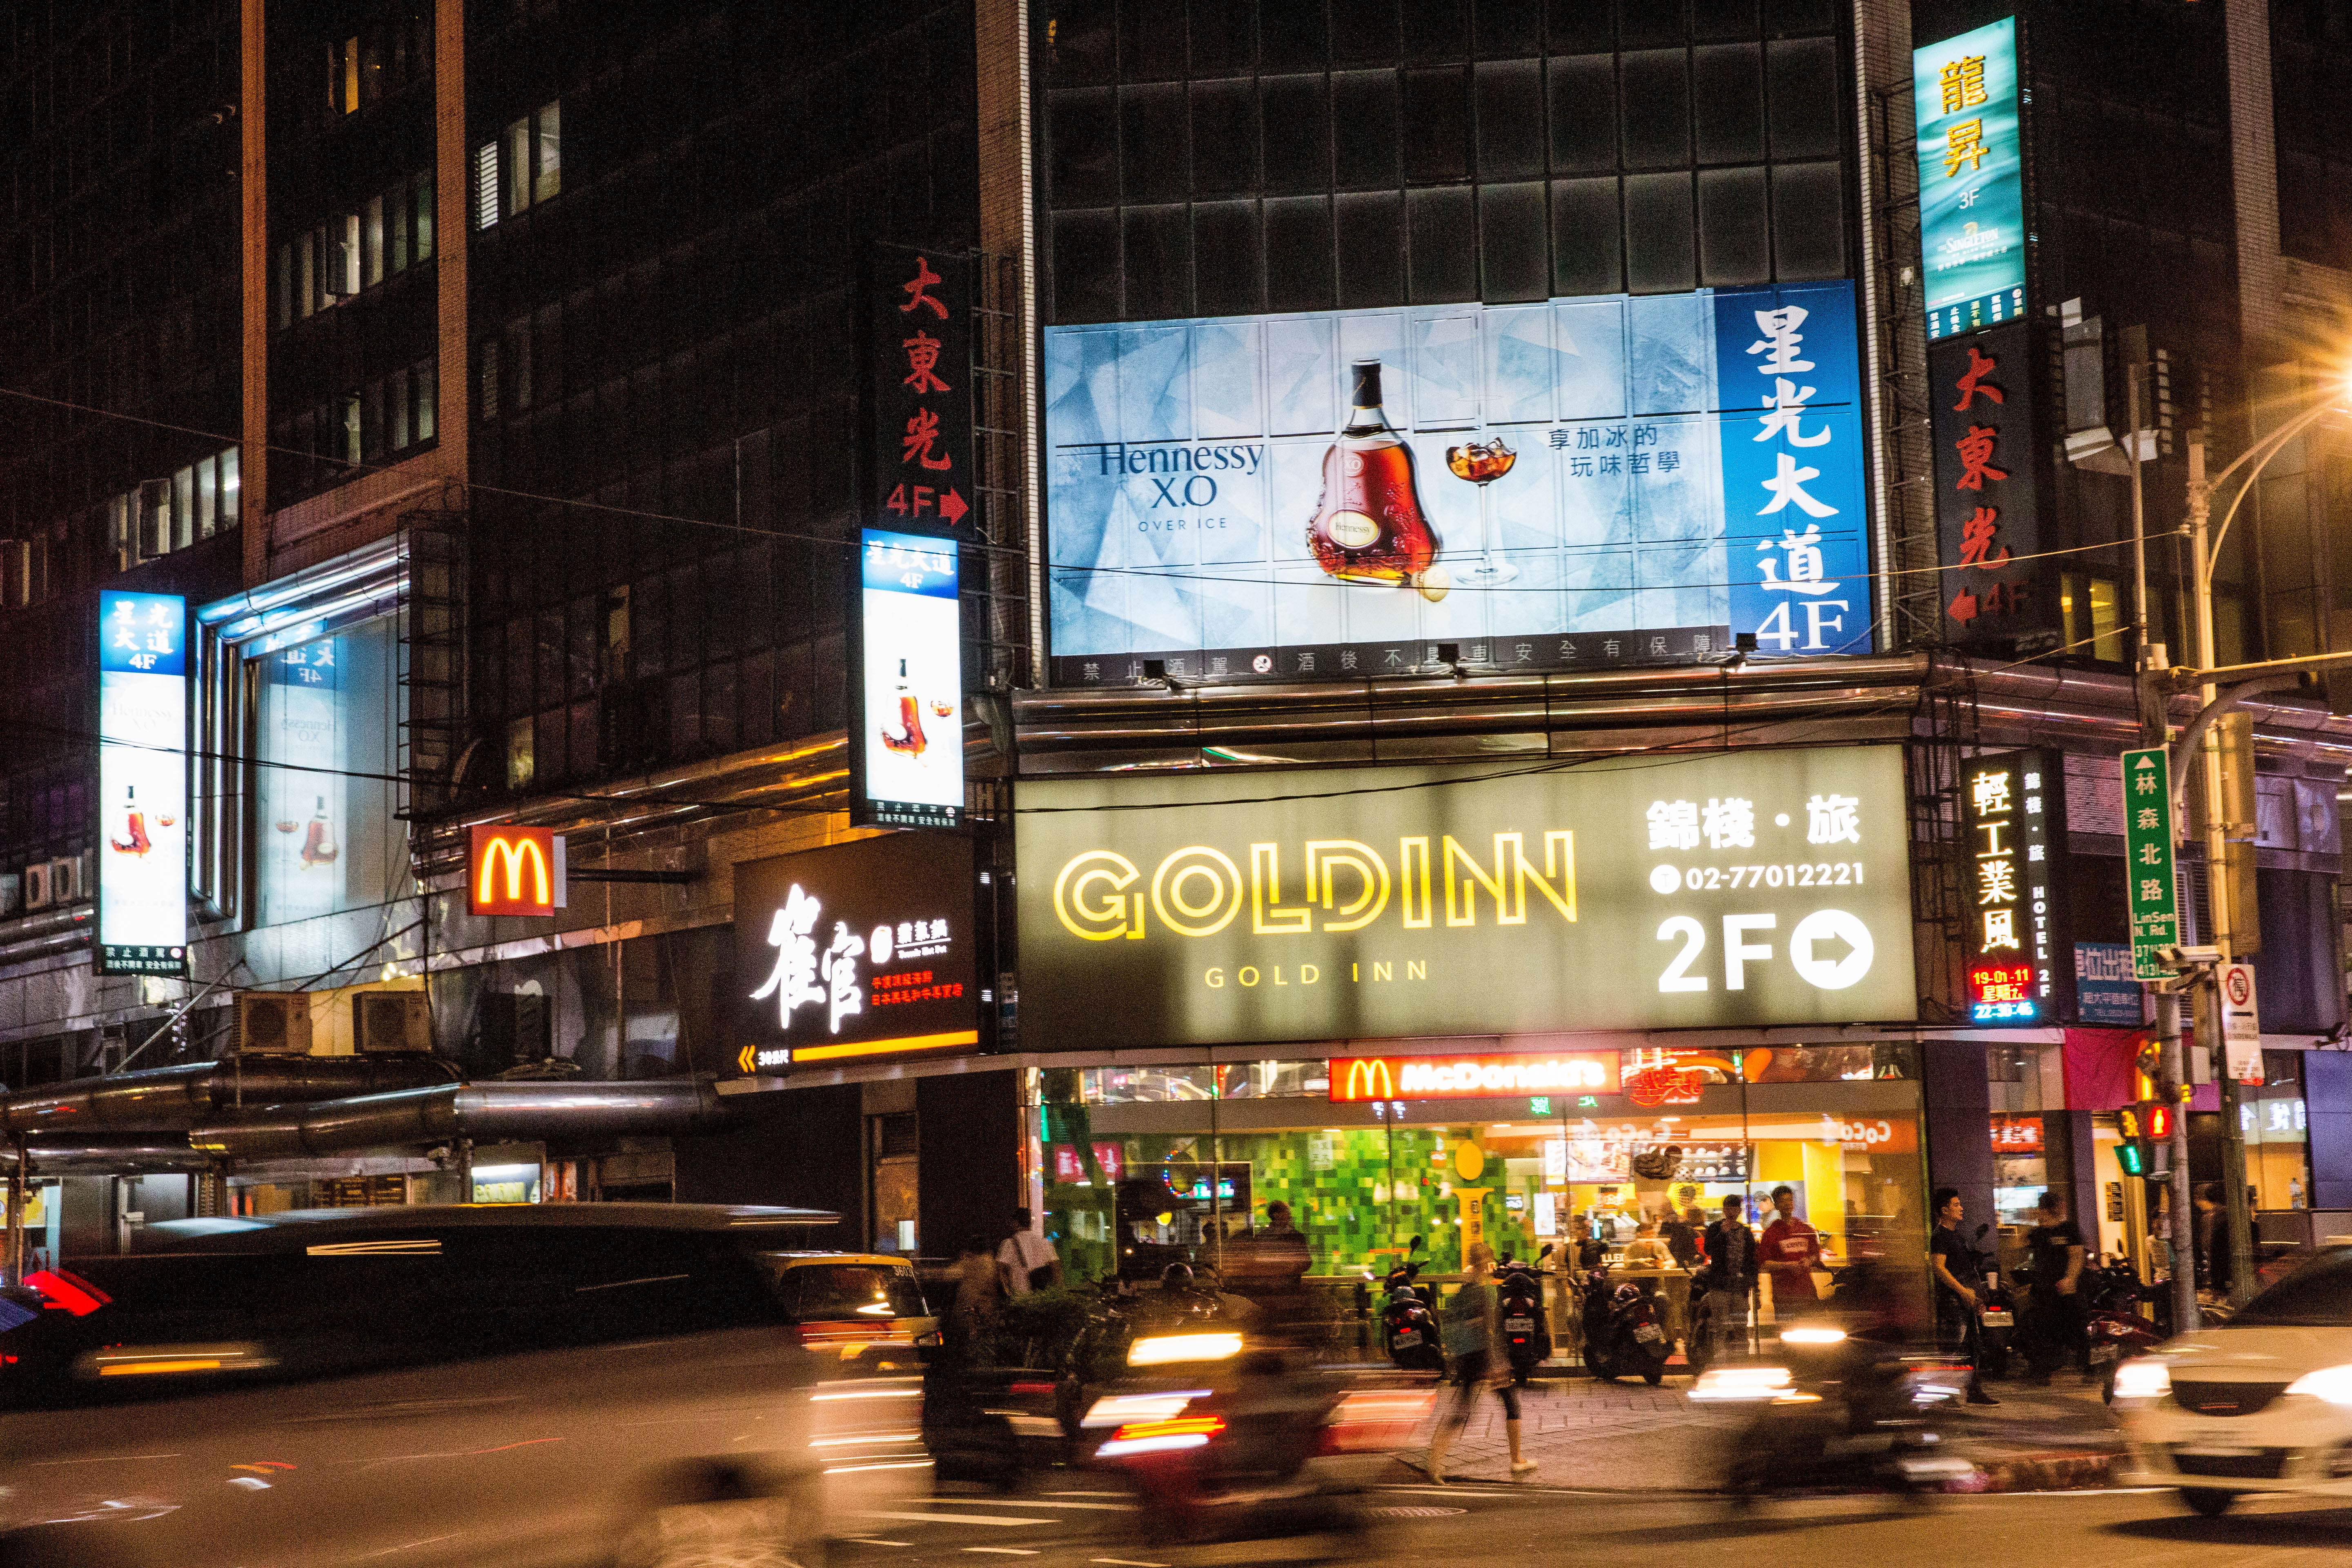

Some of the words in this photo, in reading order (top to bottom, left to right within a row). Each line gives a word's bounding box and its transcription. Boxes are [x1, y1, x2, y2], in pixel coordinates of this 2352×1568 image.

[1938, 54, 1990, 178] 龍昇
[1959, 188, 1980, 210] 3F
[900, 257, 952, 470] 大東光
[1549, 425, 1657, 450] 享加冰的
[1746, 305, 1840, 595] 星光大道
[1100, 442, 1265, 475] Hennessy
[1570, 451, 1680, 477] 玩味哲學
[1953, 347, 2010, 570] 大東光
[886, 483, 935, 517] 4F
[1138, 519, 1186, 531] OVER
[1198, 517, 1227, 528] ICE
[866, 540, 955, 576] 星光大道
[900, 572, 924, 588] 4F
[1983, 579, 2031, 612] 4F
[1755, 600, 1849, 650] 4F
[129, 654, 157, 670] 4F
[2135, 772, 2163, 901] 林森北路
[1686, 862, 1863, 890] 02-77012221
[1972, 772, 2019, 953] 輕工業風
[2032, 887, 2048, 960] HOTEL
[2133, 911, 2174, 924] LinSen
[1656, 913, 1776, 993] 2F
[1205, 963, 1320, 989] GOLD
[1352, 960, 1427, 982] INN
[2038, 969, 2050, 997] 2F
[1401, 1060, 1606, 1091] McDonald's
